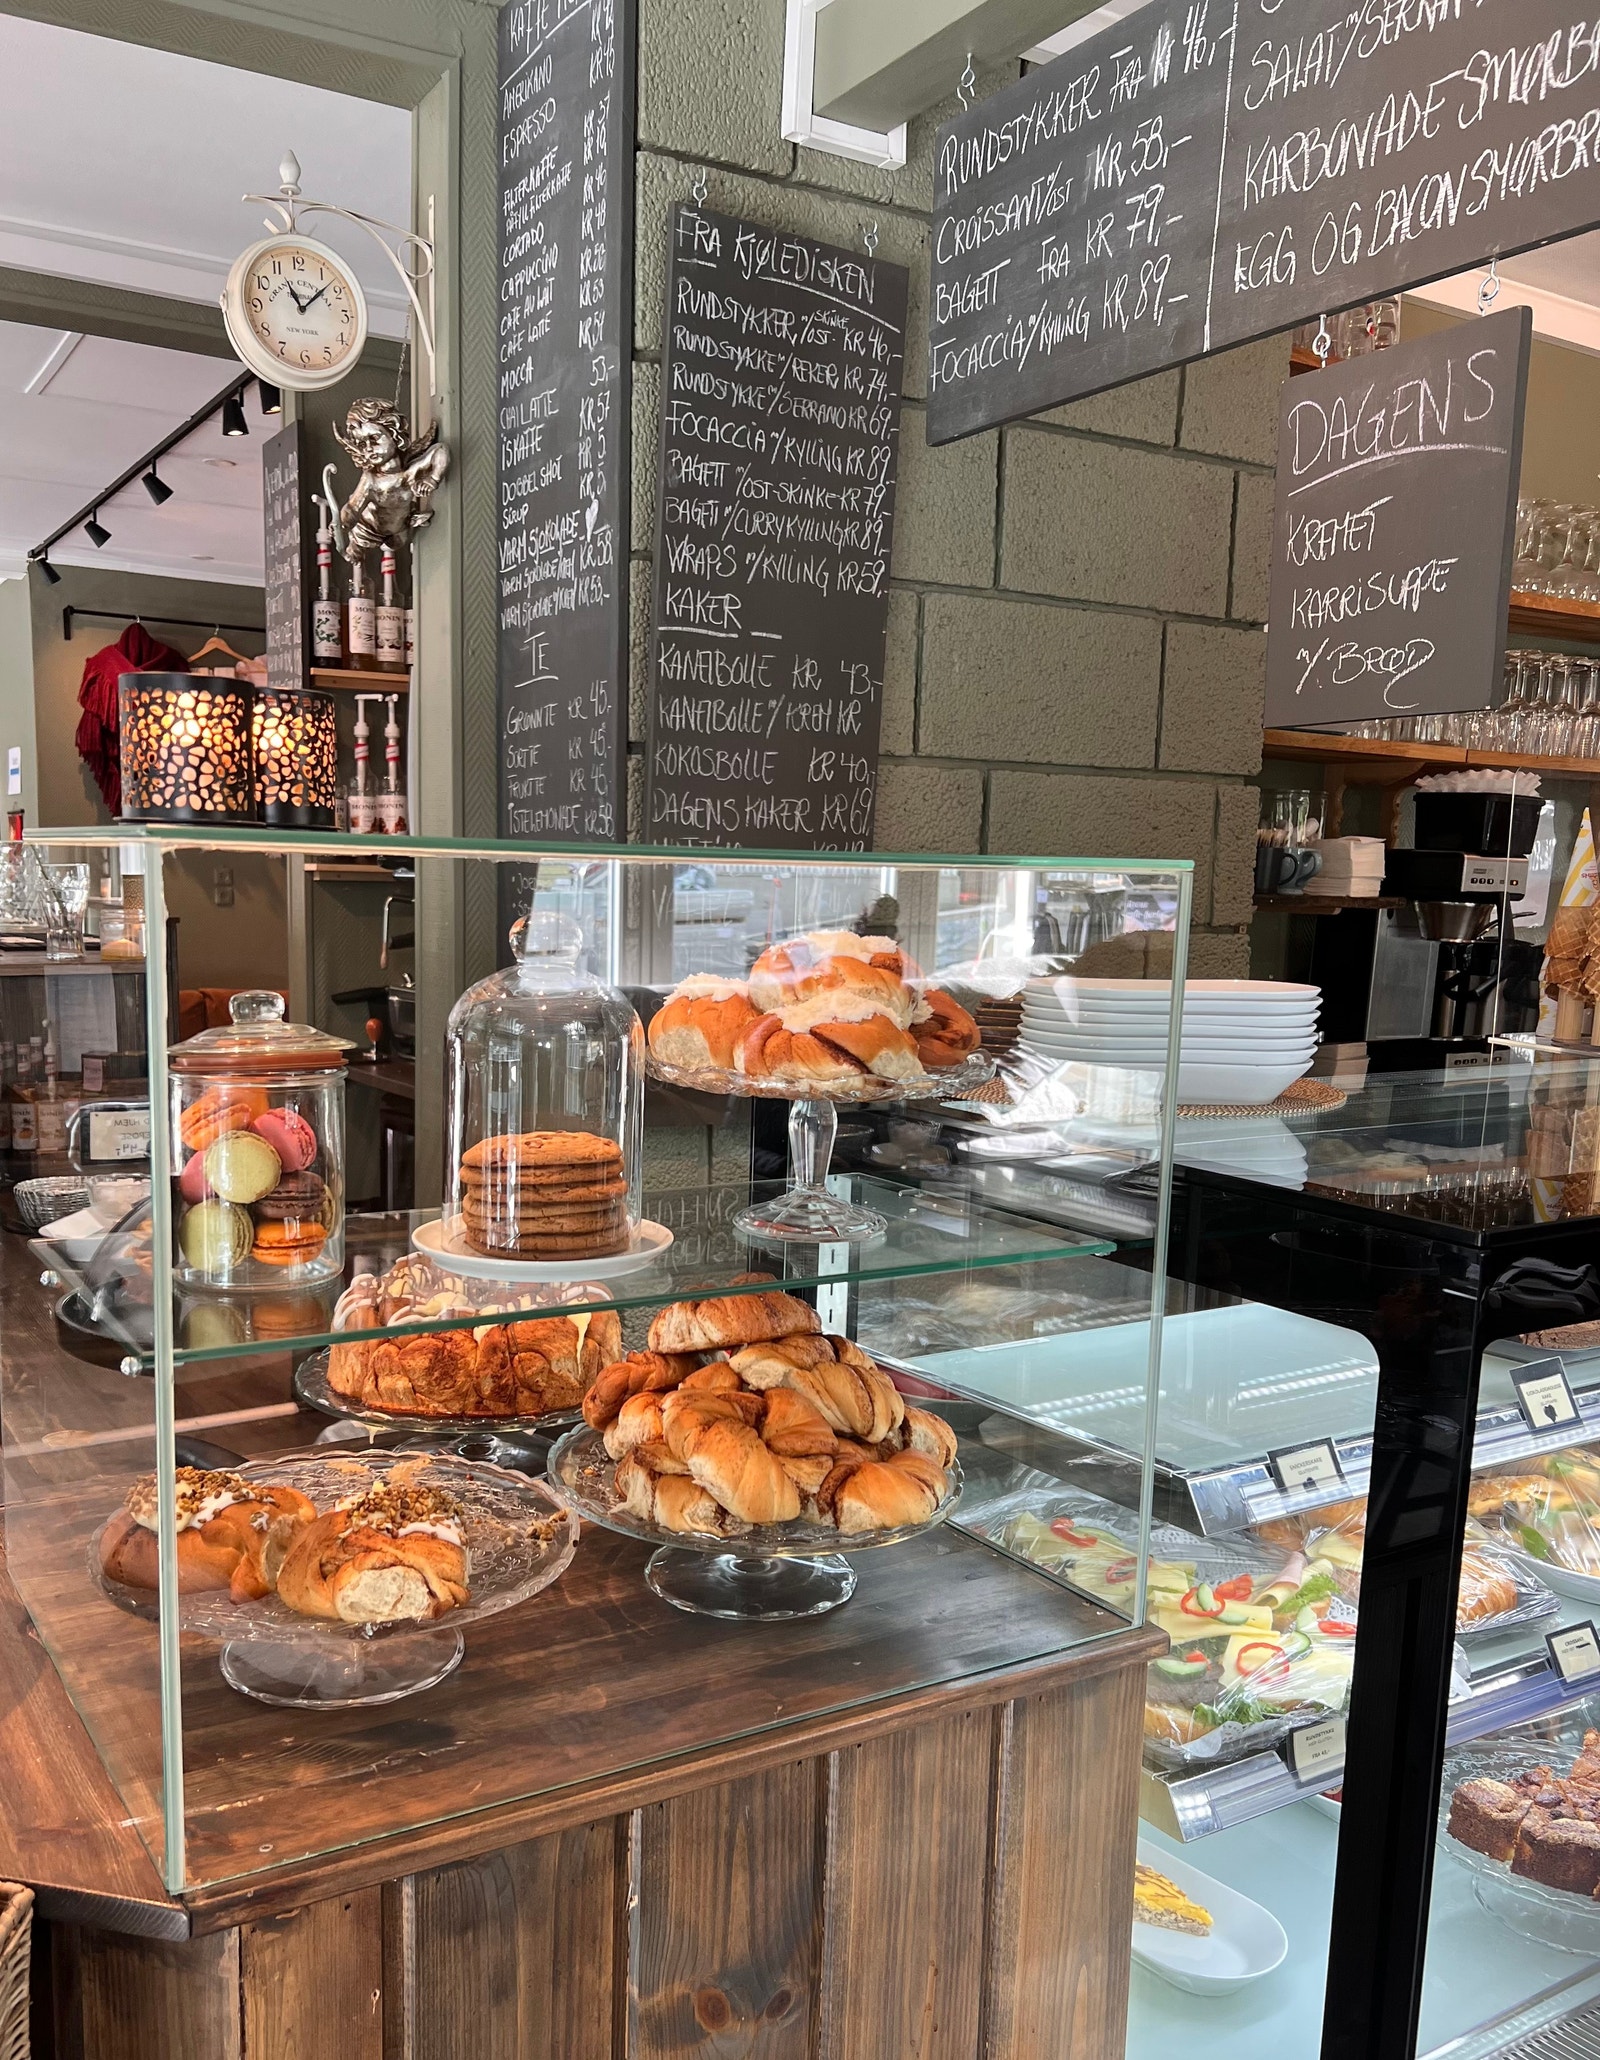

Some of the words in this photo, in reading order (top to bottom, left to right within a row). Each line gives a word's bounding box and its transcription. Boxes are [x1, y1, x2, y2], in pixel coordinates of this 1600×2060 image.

[503, 97, 556, 168] ESPRESSO
[939, 65, 1102, 196] RUNDSTYKKER
[1109, 45, 1147, 112] FRA
[1244, 69, 1465, 210] KARBONADE
[936, 175, 1045, 265] CROISSANT
[1092, 133, 1127, 190] KR
[1131, 115, 1192, 177] 58,-
[503, 221, 544, 268] CORTADO
[675, 211, 722, 257] FRA
[936, 258, 1012, 324] BAGETT
[1036, 236, 1071, 284] FRA
[1086, 212, 1114, 264] KR
[1126, 183, 1184, 249] 79,-
[1234, 225, 1297, 293] EGG
[1311, 201, 1363, 276] OG
[257, 275, 270, 291] 10
[272, 260, 282, 275] 11
[292, 256, 305, 272] 12
[319, 267, 324, 281] 1
[502, 243, 558, 301] CAPPUCCINO
[580, 246, 593, 279] KR
[251, 297, 263, 313] 9
[333, 285, 342, 300] 2
[580, 280, 592, 308] KR
[260, 322, 271, 337] 8
[302, 328, 319, 336] YORK
[335, 332, 346, 345] 4
[341, 309, 350, 324] 3
[677, 276, 798, 347] RUNDSTYKKER
[843, 327, 867, 356] KR
[868, 325, 903, 366] 46,-
[930, 315, 1026, 392] FOCACCIA
[1102, 273, 1129, 333] KR
[1134, 254, 1189, 327] 89,-
[278, 340, 286, 356] 7
[300, 349, 311, 363] 6
[323, 346, 332, 361] 5
[501, 356, 534, 398] MOCCA
[579, 317, 594, 350] KR
[673, 325, 775, 372] RUNDSTYKKE
[844, 364, 864, 395] KR
[867, 368, 897, 402] 74,-
[579, 397, 596, 437] KR
[597, 390, 610, 423] 57
[672, 362, 767, 411] RUNDSTYKKE
[848, 405, 868, 434] KR
[869, 404, 900, 441] 69,-
[1288, 349, 1497, 476] DAGENS
[578, 437, 592, 470] KR
[665, 400, 767, 452] FOCACCIA
[845, 445, 866, 477] KR
[502, 503, 529, 530] SIRUP
[579, 471, 595, 500] KR
[667, 449, 731, 489] BAGETT
[841, 486, 860, 512] KR
[863, 484, 893, 519] 79,-
[664, 497, 720, 530] BAGETT
[842, 518, 860, 549] KR
[860, 519, 891, 557] 89,-
[579, 543, 597, 572] KR
[665, 534, 737, 581] WRAPS
[837, 561, 860, 595] KR
[860, 560, 889, 598] 59,-
[666, 582, 742, 629] KAKER
[524, 631, 550, 676] TE
[792, 654, 823, 691] KR
[841, 660, 884, 703] 43,-
[543, 703, 558, 726] TE
[568, 696, 588, 720] KR
[836, 700, 862, 735] KR
[568, 737, 583, 760] KR
[655, 740, 779, 785] KOKOSBOLLE
[808, 747, 835, 782] KR
[841, 752, 877, 785] 40,-
[570, 768, 587, 792] KR
[652, 788, 740, 832] DAGENS
[745, 795, 814, 833] KAKER
[820, 794, 847, 833] KR
